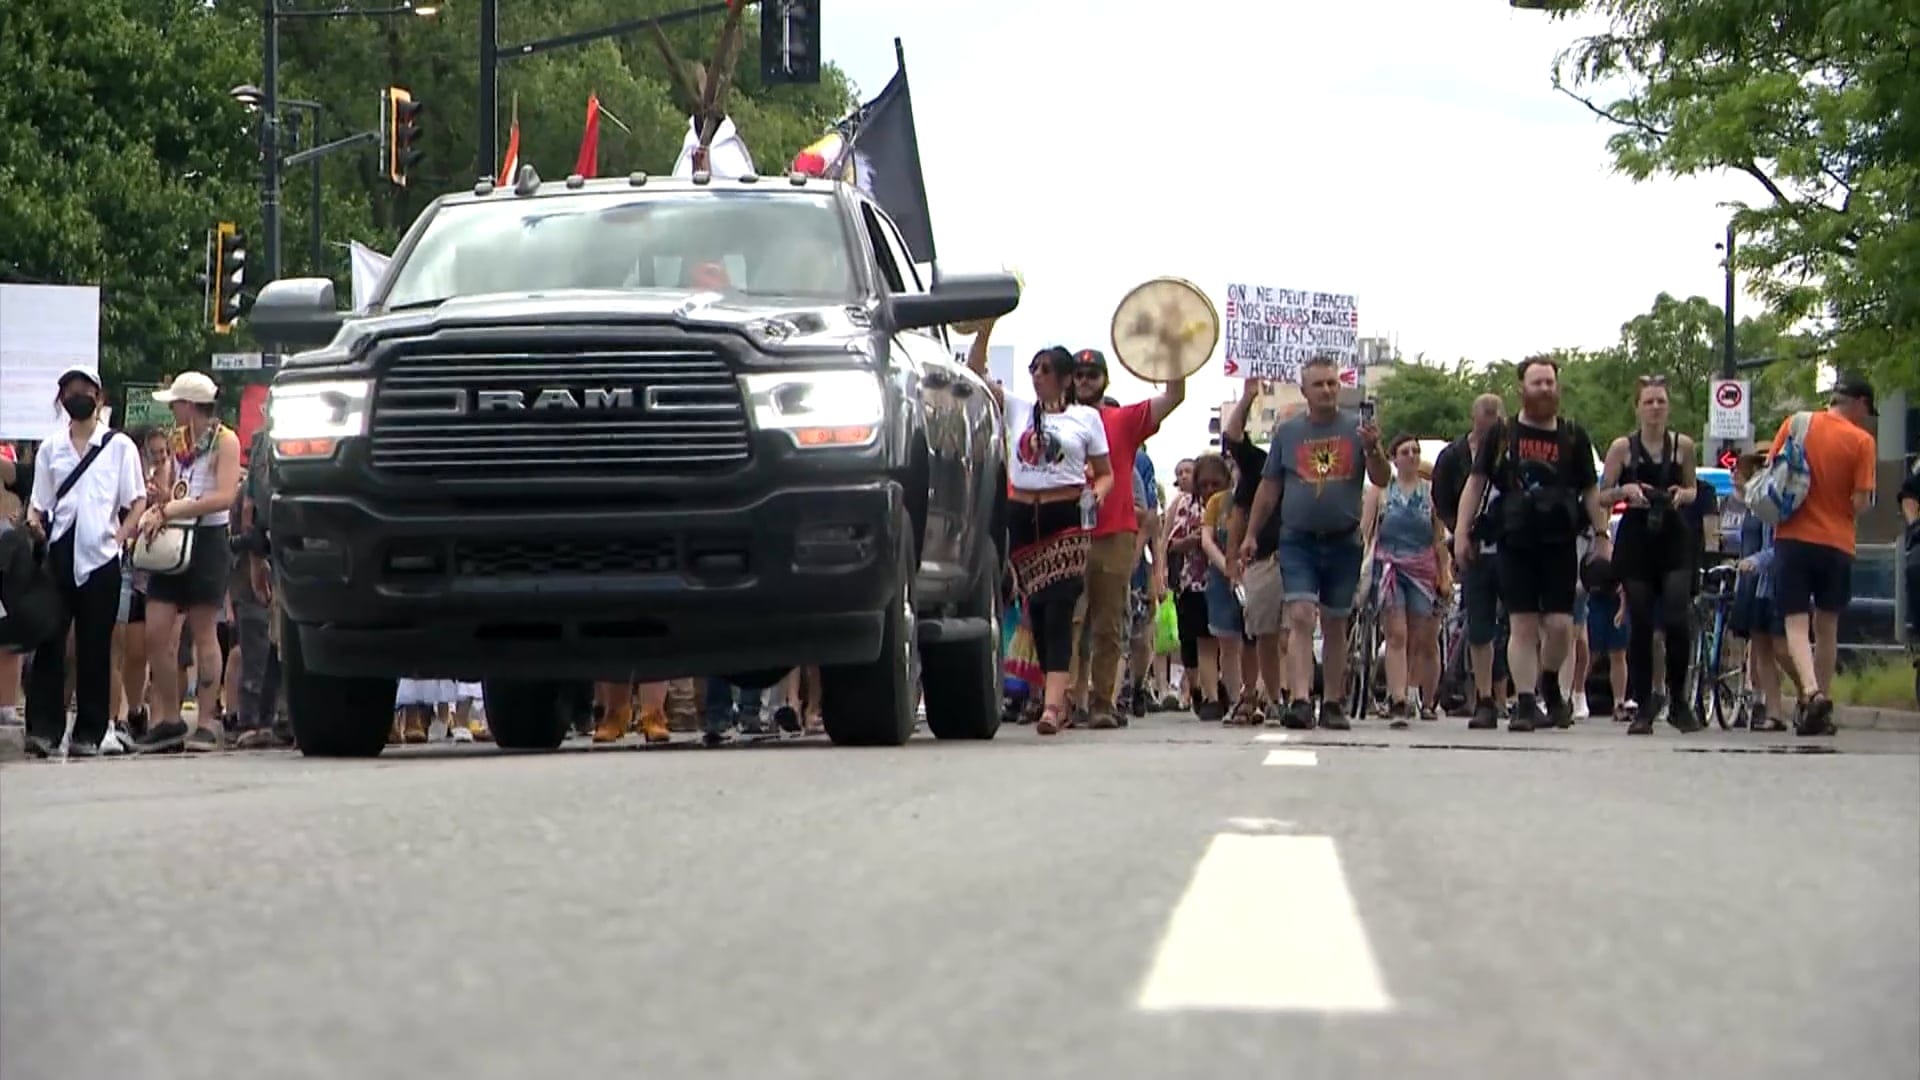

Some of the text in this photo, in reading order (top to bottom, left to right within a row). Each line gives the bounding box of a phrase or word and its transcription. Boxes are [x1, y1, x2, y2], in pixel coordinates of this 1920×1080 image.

[1227, 283, 1356, 310] ON NE PEUT EFFACER
[1236, 302, 1261, 321] NOS
[1264, 304, 1310, 328] ERREURS
[1226, 319, 1239, 340] LE
[1286, 325, 1304, 345] EST
[1226, 340, 1240, 360] LA
[477, 388, 633, 410] RAM
